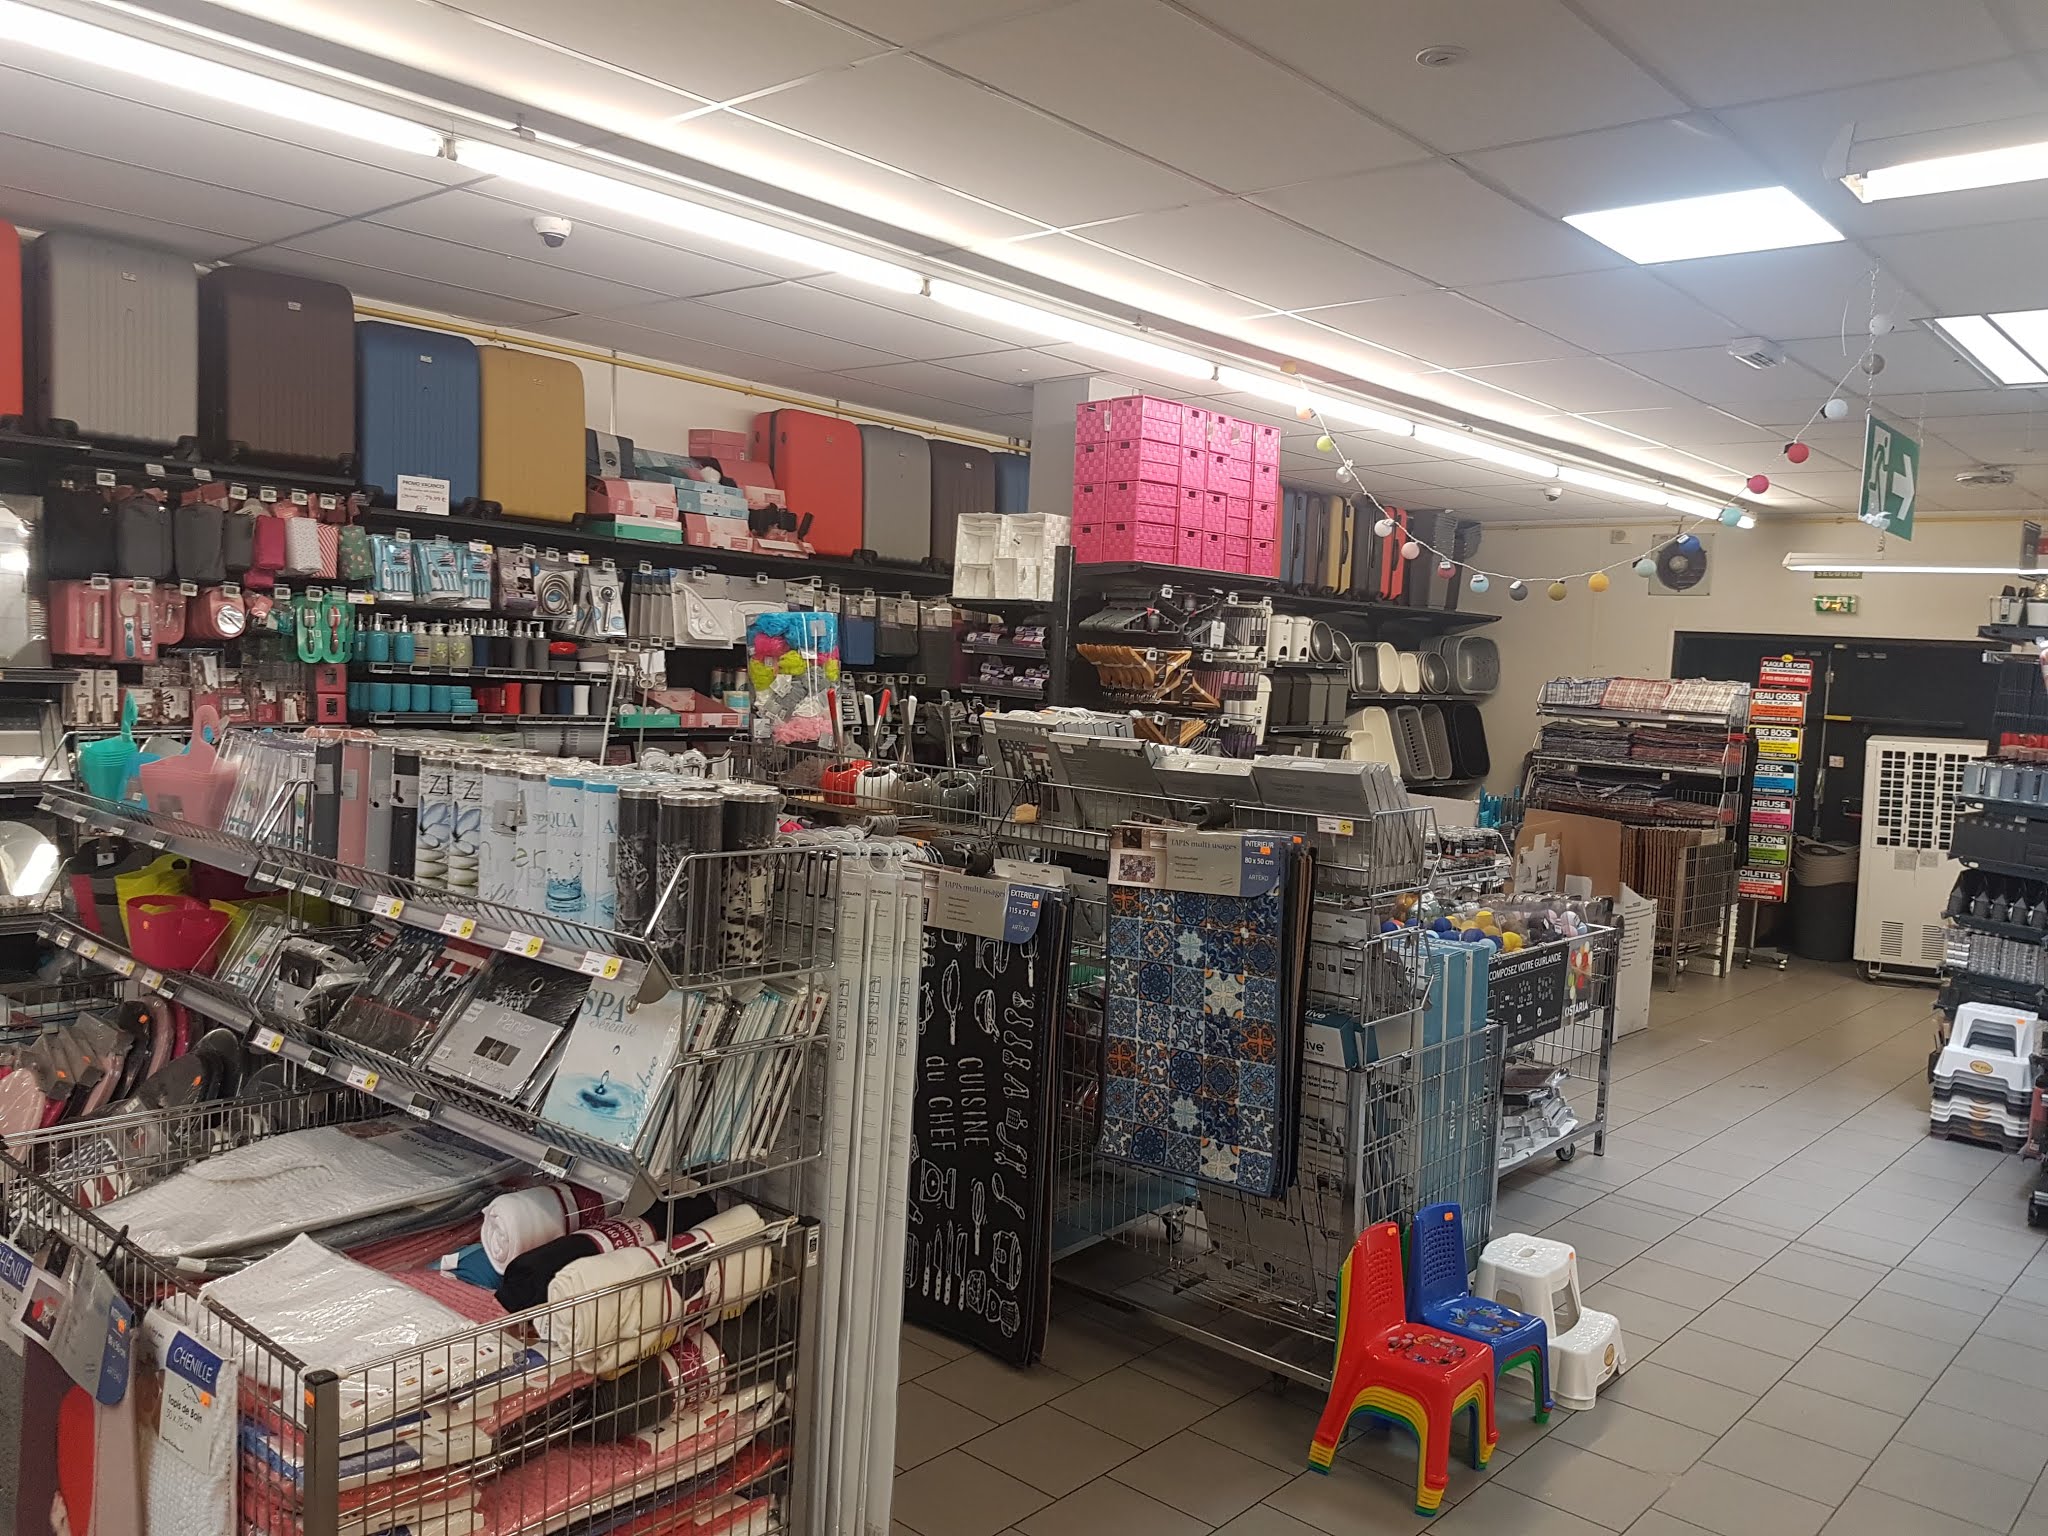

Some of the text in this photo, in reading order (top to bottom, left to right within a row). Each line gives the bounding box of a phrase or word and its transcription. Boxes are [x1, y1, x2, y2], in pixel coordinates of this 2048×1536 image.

[1752, 800, 1786, 808] HIEUSE
[548, 812, 578, 828] QUA
[1171, 839, 1190, 848] TAPIS
[1245, 840, 1274, 848] INTERIEUR
[1761, 836, 1784, 844] ZONE
[1740, 870, 1781, 880] OILETTES
[944, 881, 1006, 898] TAPIS multi usages
[1489, 952, 1562, 981] COMPOSEZ VOTRE GUIRLANDE
[580, 988, 627, 1024] SPA
[496, 1012, 536, 1036] Panier
[1304, 1038, 1324, 1052] ive
[926, 1056, 957, 1150] du CHEF
[958, 1056, 990, 1146] CUISINE
[0, 1247, 26, 1288] HENILL
[173, 1346, 214, 1384] CHENILLE
[168, 1394, 181, 1410] Tapis
[182, 1406, 189, 1415] de
[190, 1408, 203, 1424] Bain
